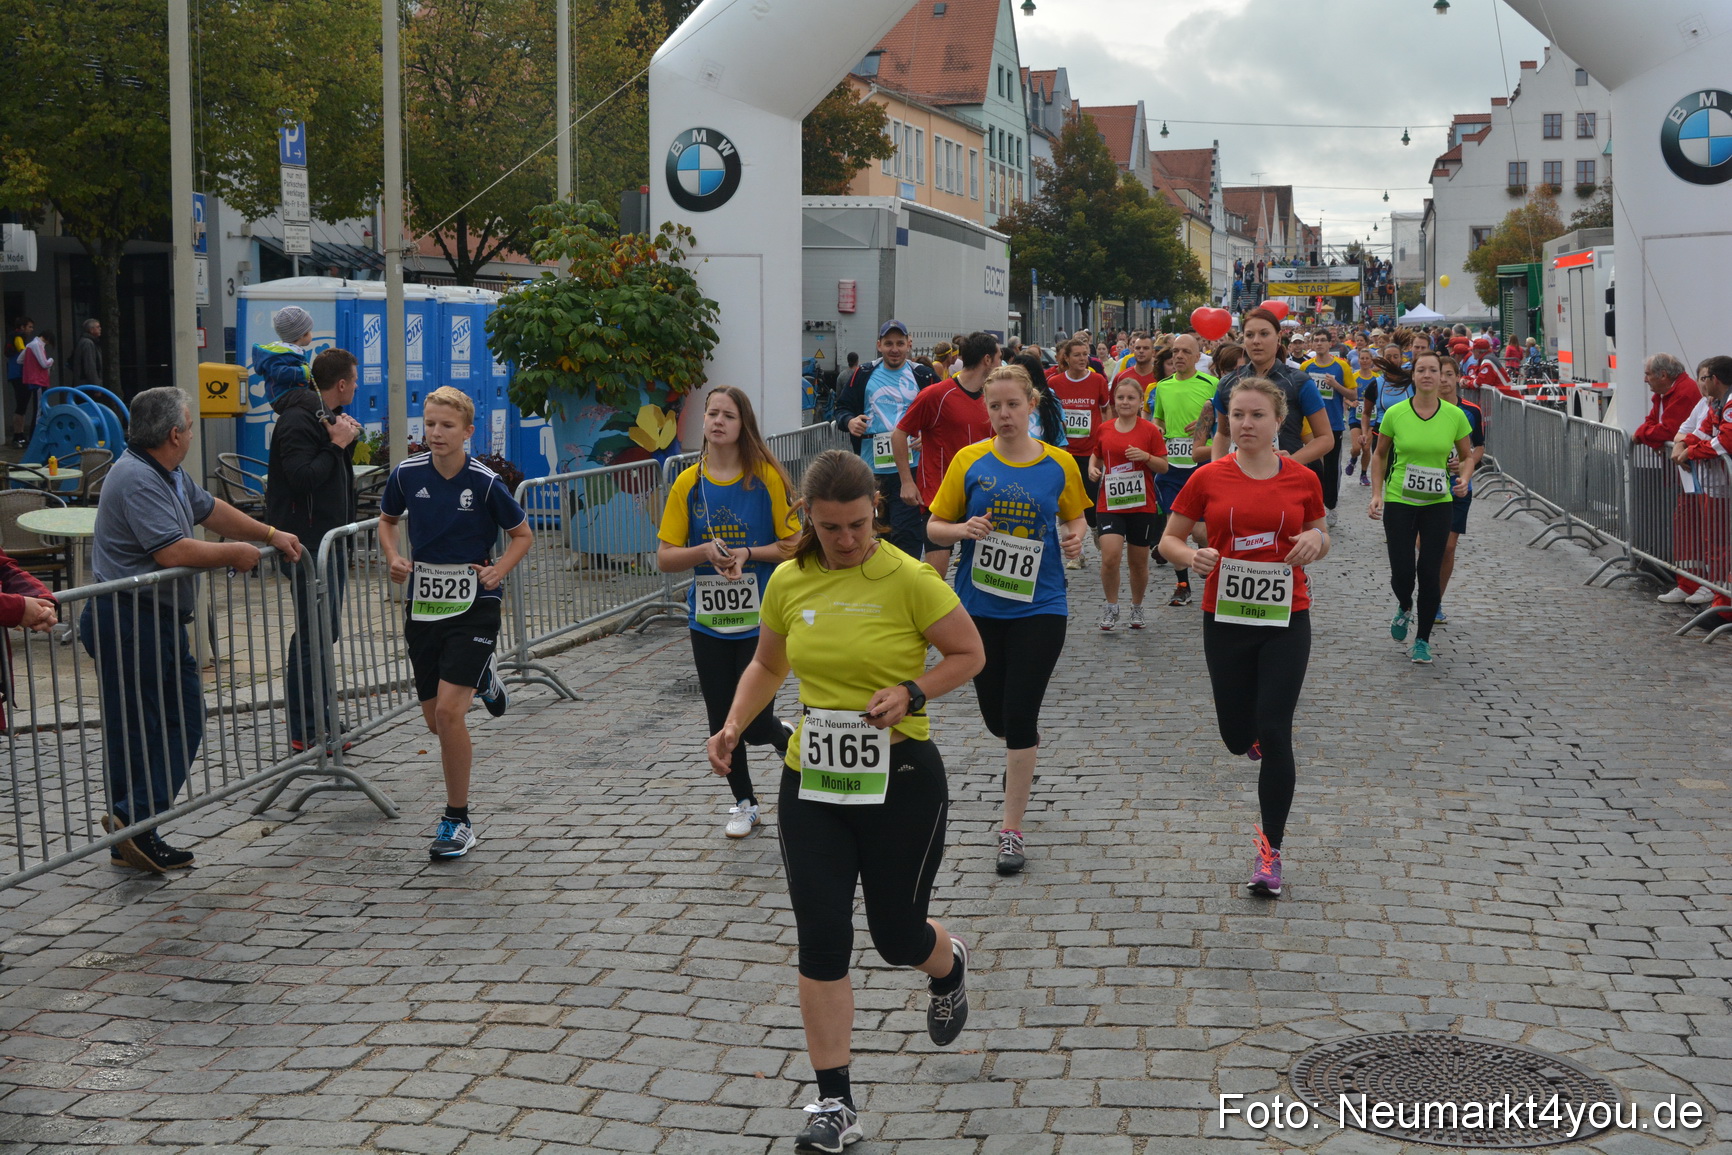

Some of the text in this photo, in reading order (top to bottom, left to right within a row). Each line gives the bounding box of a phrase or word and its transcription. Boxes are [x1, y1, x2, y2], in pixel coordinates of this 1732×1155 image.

[1668, 91, 1732, 125] BM
[671, 129, 735, 157] BMW
[7, 253, 24, 262] Mode
[227, 277, 235, 297] 3
[1297, 285, 1329, 293] START
[877, 440, 891, 454] 51
[1109, 479, 1142, 496] 5044
[1407, 474, 1443, 492] 5516
[1001, 540, 1032, 552] Neumarkt
[1245, 537, 1264, 547] DEHN
[980, 544, 1034, 578] 5018
[1221, 563, 1281, 576] PARTL Neumarkt
[415, 566, 465, 576] PARTL Neumarkt
[419, 577, 471, 600] 5528
[984, 574, 1019, 591] Stefanie
[1225, 574, 1286, 602] 5025
[702, 587, 753, 612] 5092
[417, 602, 469, 615] Thomas
[1240, 605, 1266, 618] Tanja
[712, 616, 744, 625] Barbara
[804, 716, 871, 729] PARTL Neumarkt
[808, 731, 880, 768] 5165
[821, 774, 861, 791] Monika
